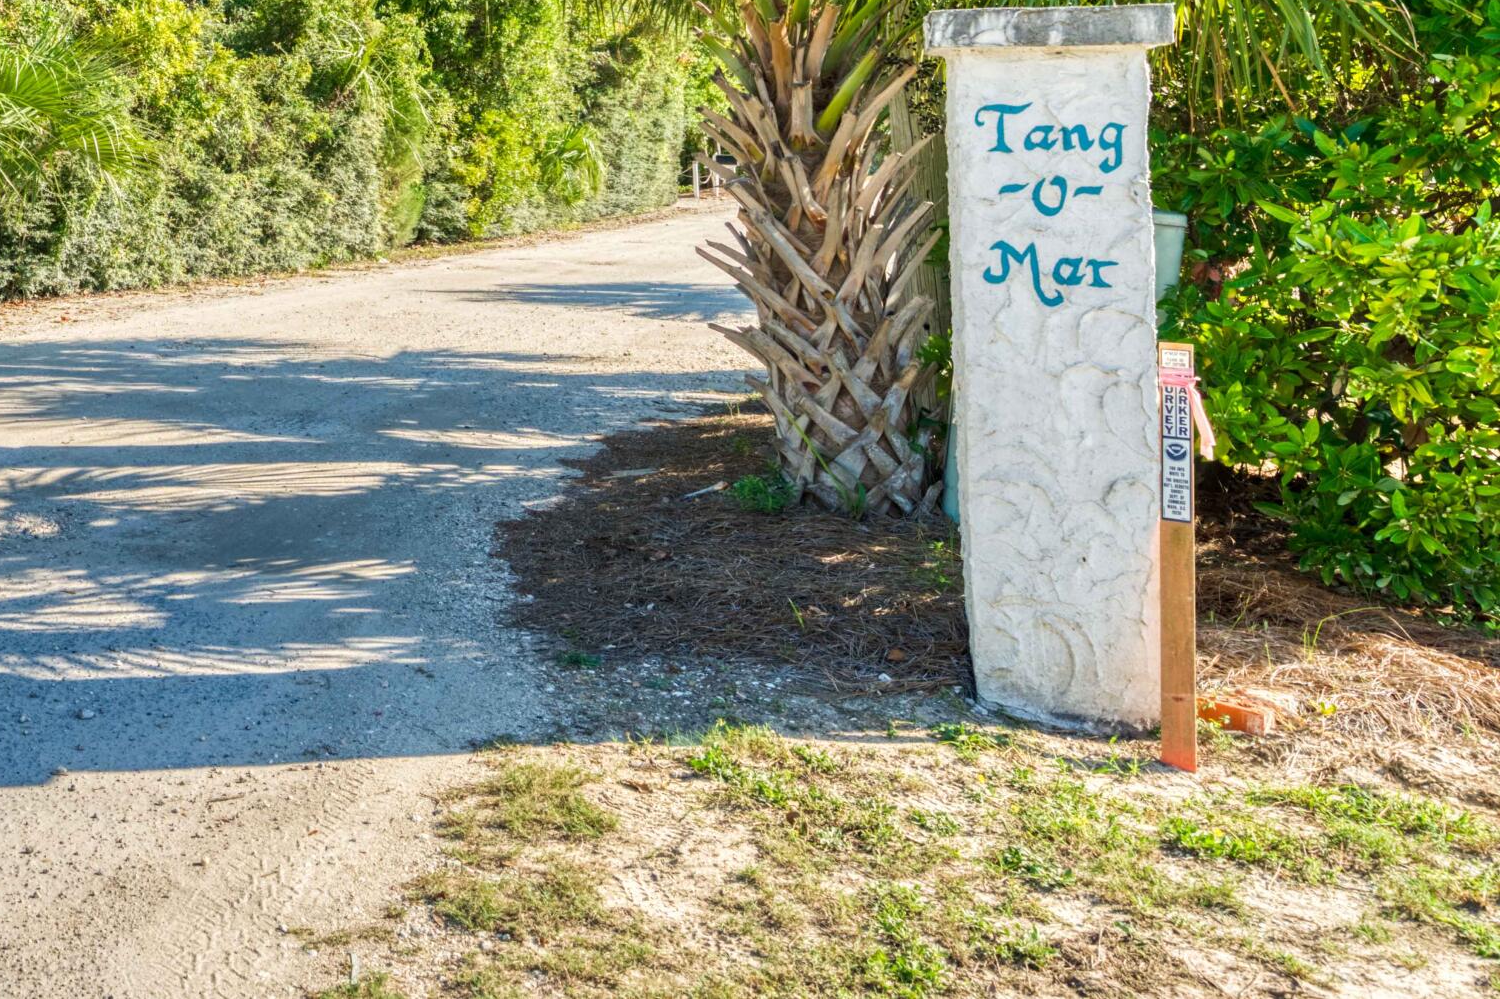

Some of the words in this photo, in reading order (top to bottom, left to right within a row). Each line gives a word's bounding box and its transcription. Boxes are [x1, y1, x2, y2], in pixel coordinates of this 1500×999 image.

[975, 102, 1128, 173] Tang
[983, 240, 1120, 307] Mar
[1164, 386, 1174, 435] URVEY
[1178, 387, 1188, 436] ARKER
